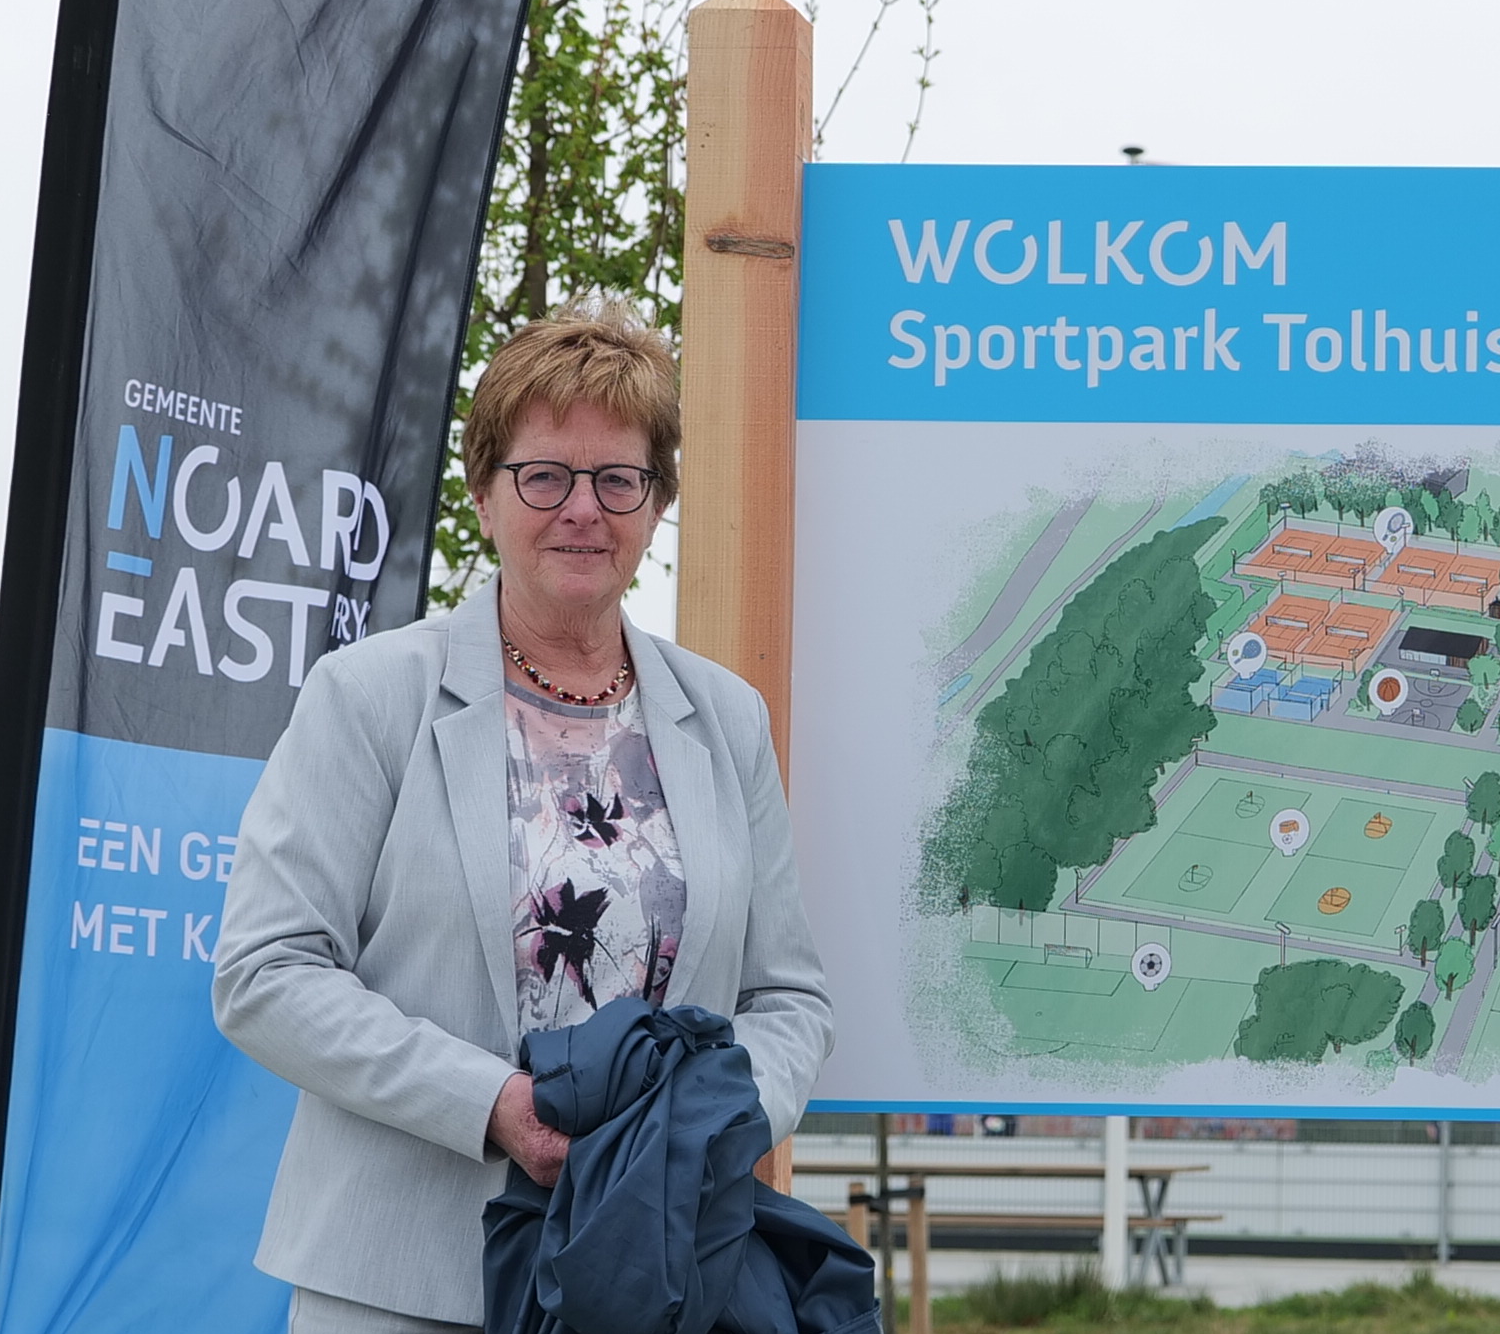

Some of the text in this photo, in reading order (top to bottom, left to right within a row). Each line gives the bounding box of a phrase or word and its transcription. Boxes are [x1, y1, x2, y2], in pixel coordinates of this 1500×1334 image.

[887, 218, 1287, 287] WOLKOM
[887, 308, 1241, 388] Sportpark
[124, 379, 243, 435] GEMEENTE
[107, 424, 390, 581] NOARD
[95, 551, 330, 688] EAST
[331, 593, 372, 643] FRY
[78, 817, 161, 875] EEN
[70, 900, 168, 957] MET
